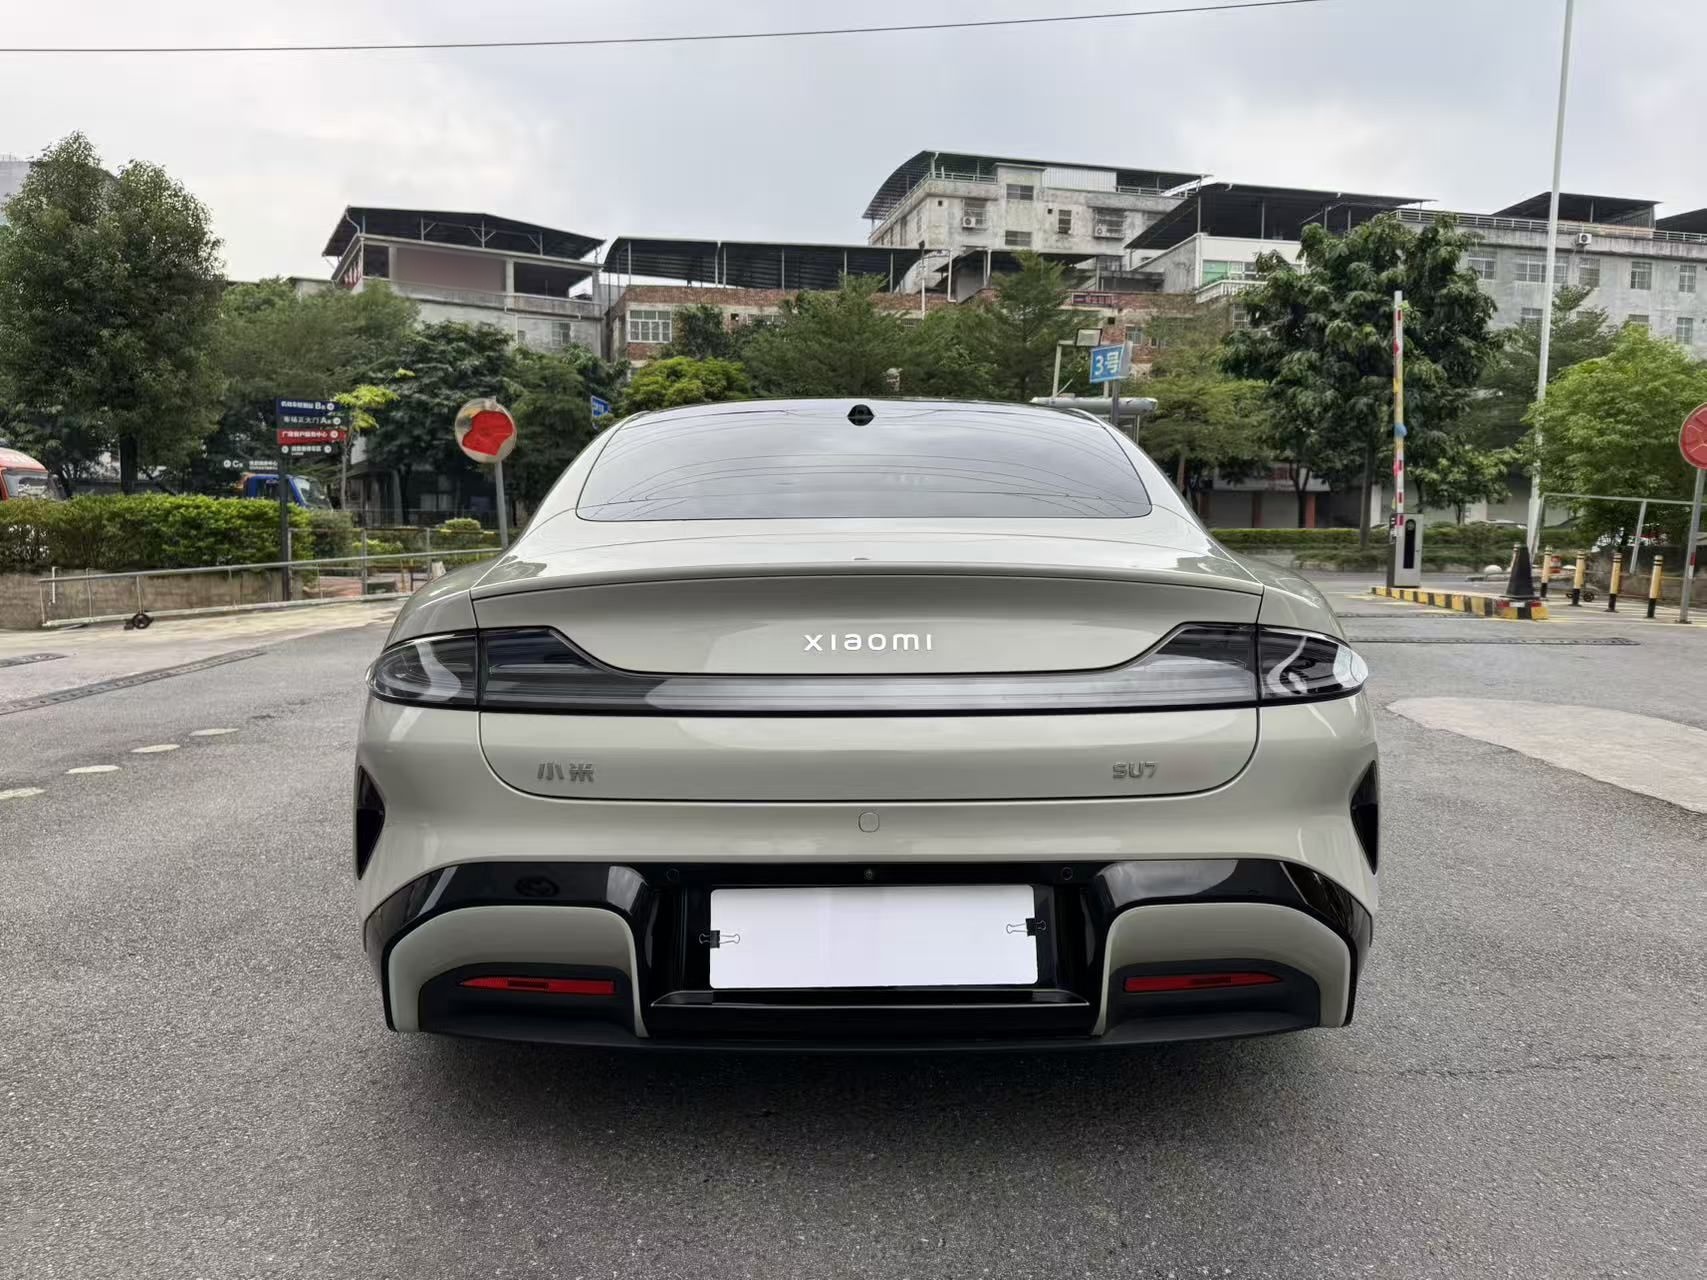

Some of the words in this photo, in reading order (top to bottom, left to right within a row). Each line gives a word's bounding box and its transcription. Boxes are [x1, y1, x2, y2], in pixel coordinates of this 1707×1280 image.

[1095, 352, 1119, 375] 3号
[804, 633, 932, 651] xiaomi
[537, 762, 594, 781] 小米
[1112, 761, 1158, 779] SU7
